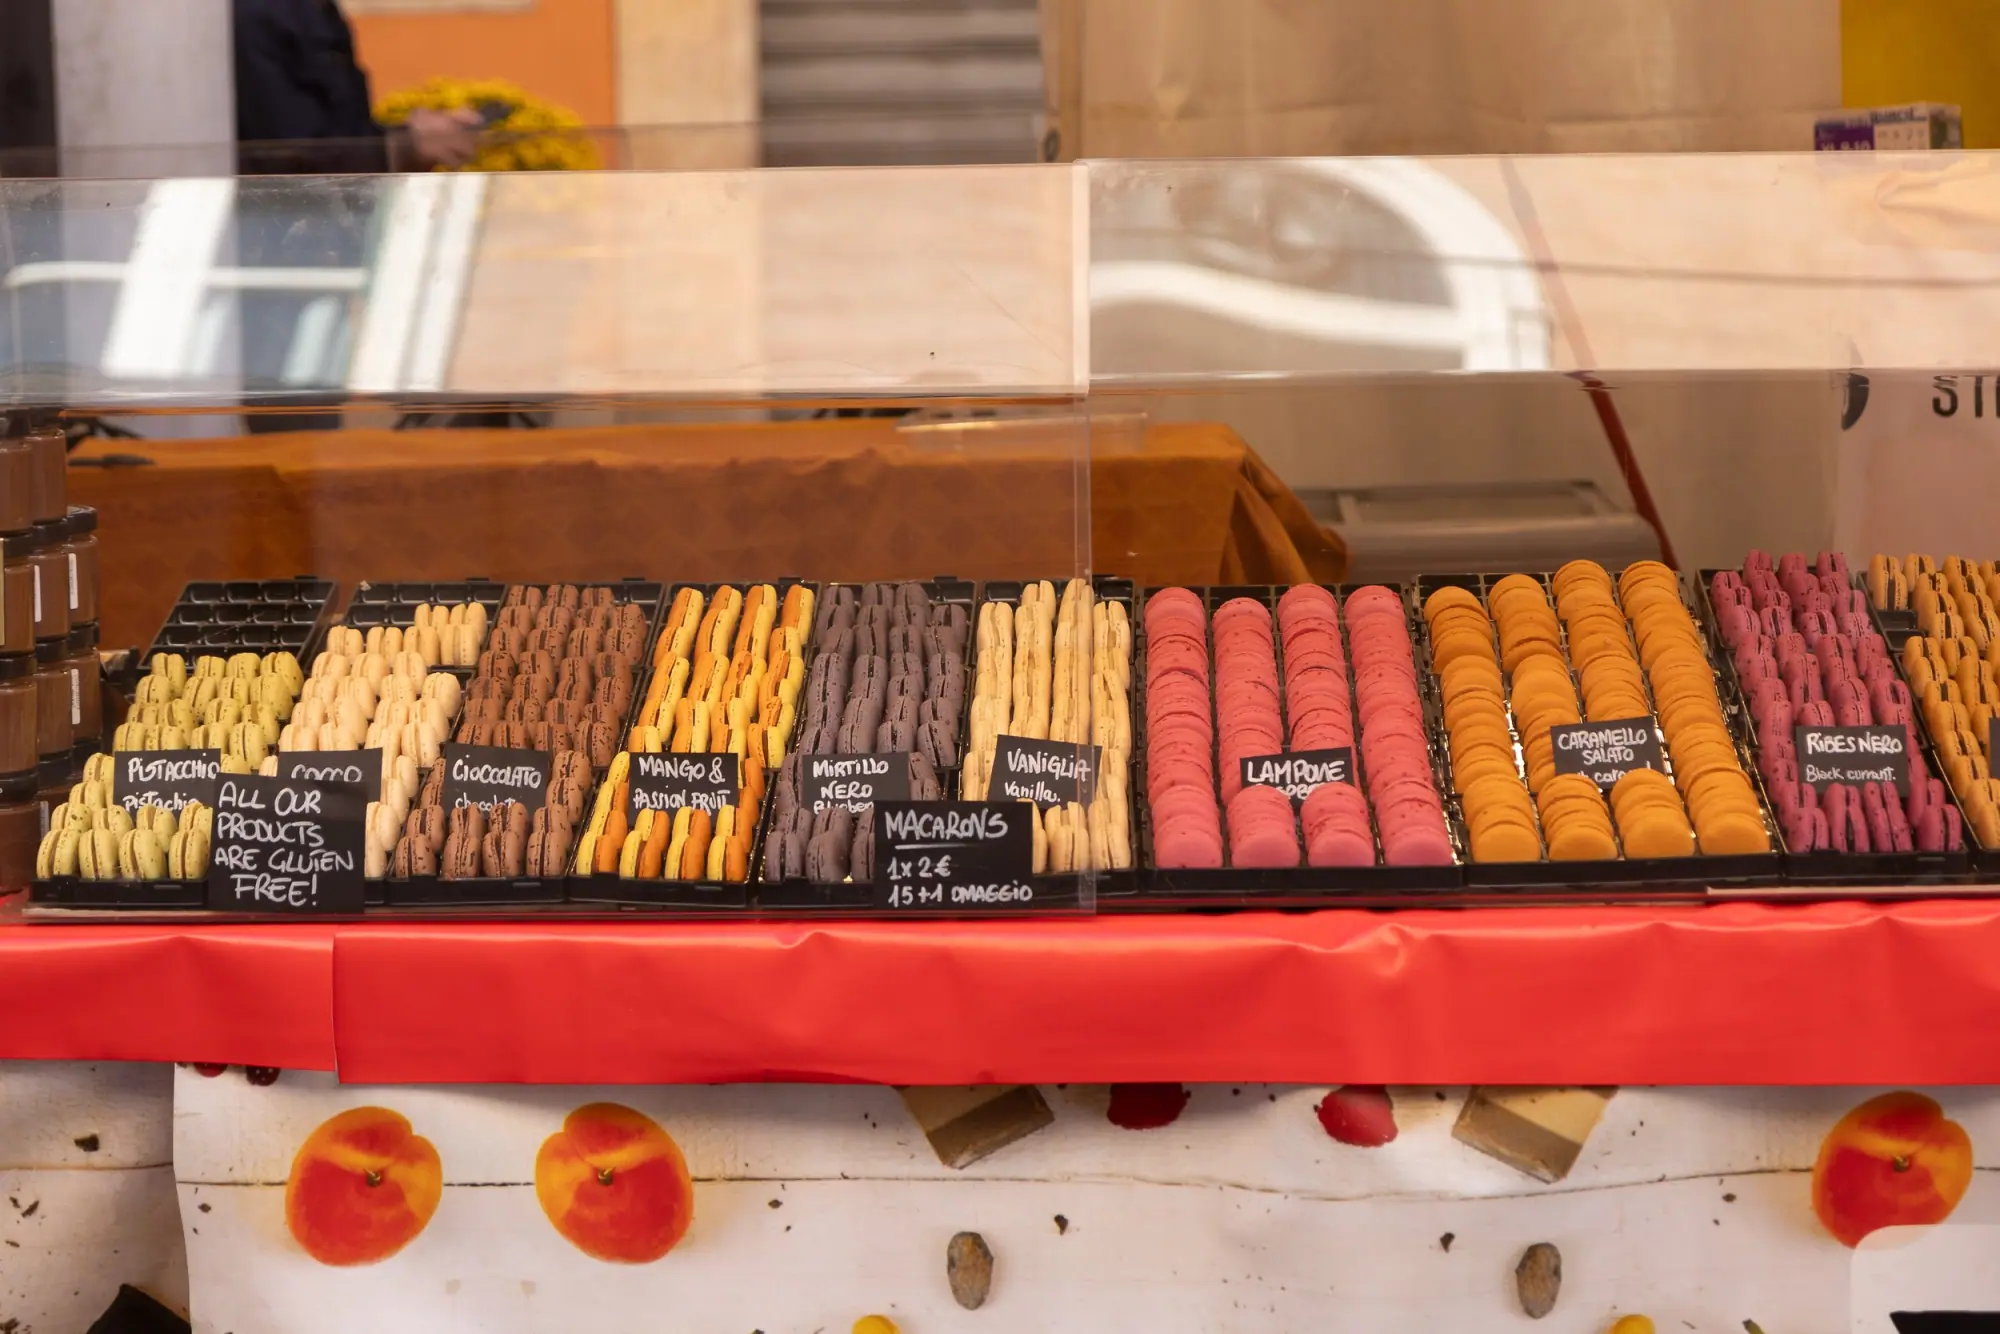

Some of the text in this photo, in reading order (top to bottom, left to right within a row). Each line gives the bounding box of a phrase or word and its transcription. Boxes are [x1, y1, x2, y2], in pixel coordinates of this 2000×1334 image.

[1932, 374, 2000, 418] ST
[1558, 728, 1647, 750] CARAMELLO
[1806, 731, 1903, 754] RiBES NERO
[128, 752, 220, 783] PiSTACCHiO
[639, 755, 726, 784] MANGO &
[812, 757, 889, 778] MiRTiLLO
[1007, 748, 1091, 782] VANiGLiA
[1582, 746, 1635, 765] SALATO
[452, 754, 542, 789] CiOCCOLATO
[1247, 759, 1345, 784] LAMPONE
[1805, 764, 1844, 782] Black
[219, 781, 321, 817] ALL OUR
[820, 780, 873, 799] NERO
[217, 812, 325, 848] PRODUCTS
[884, 807, 1009, 841] MACARONS
[214, 844, 354, 874] ARE GLUTEN
[229, 872, 318, 907] FREE!
[950, 880, 1034, 904] OMAGGiO
